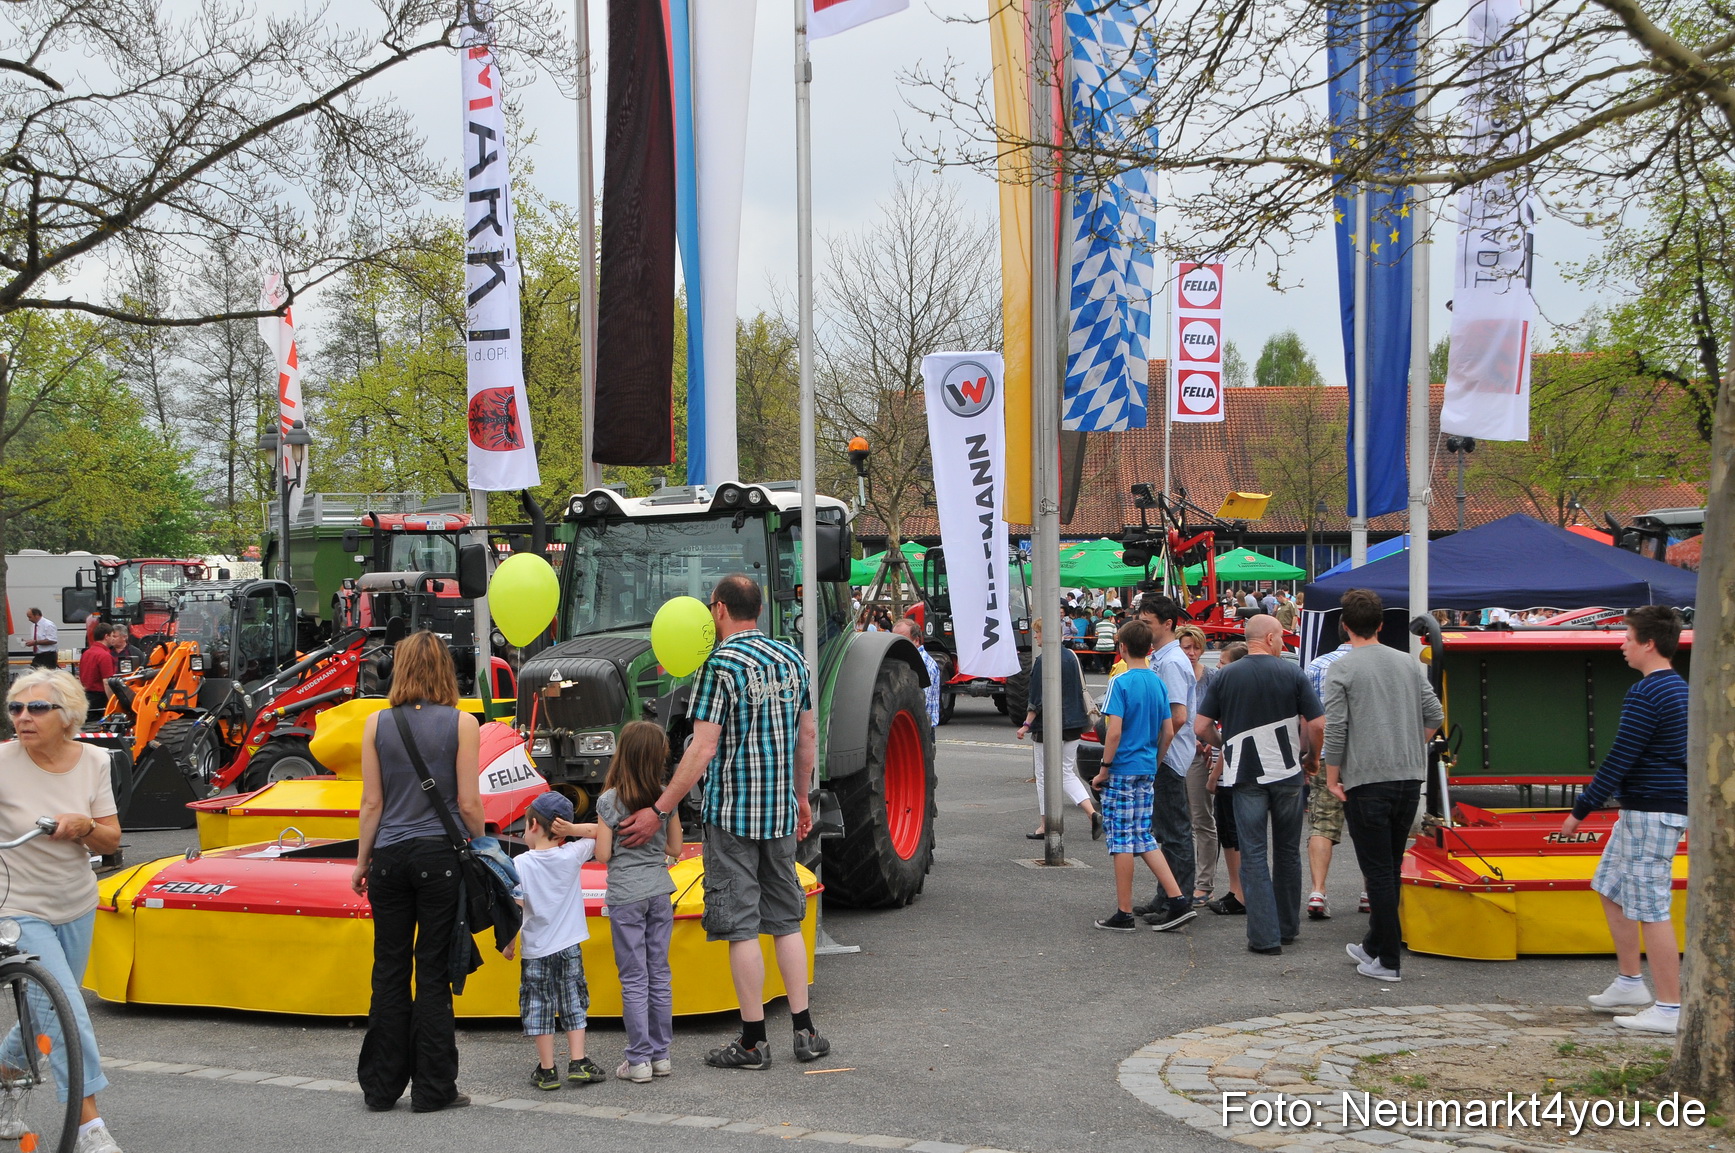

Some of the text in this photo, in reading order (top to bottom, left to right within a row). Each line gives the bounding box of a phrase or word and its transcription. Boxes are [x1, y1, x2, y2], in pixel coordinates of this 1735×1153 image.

[1183, 280, 1218, 292] FELLA
[1183, 333, 1216, 346] FELLA
[1182, 386, 1216, 399] FELLA
[1570, 615, 1596, 625] MASSEY
[1597, 609, 1625, 619] FERGUSO
[296, 667, 338, 695] WEIDEMANN
[488, 764, 535, 790] FELLA
[1547, 831, 1597, 844] FELLA
[156, 881, 226, 896] FELLA
